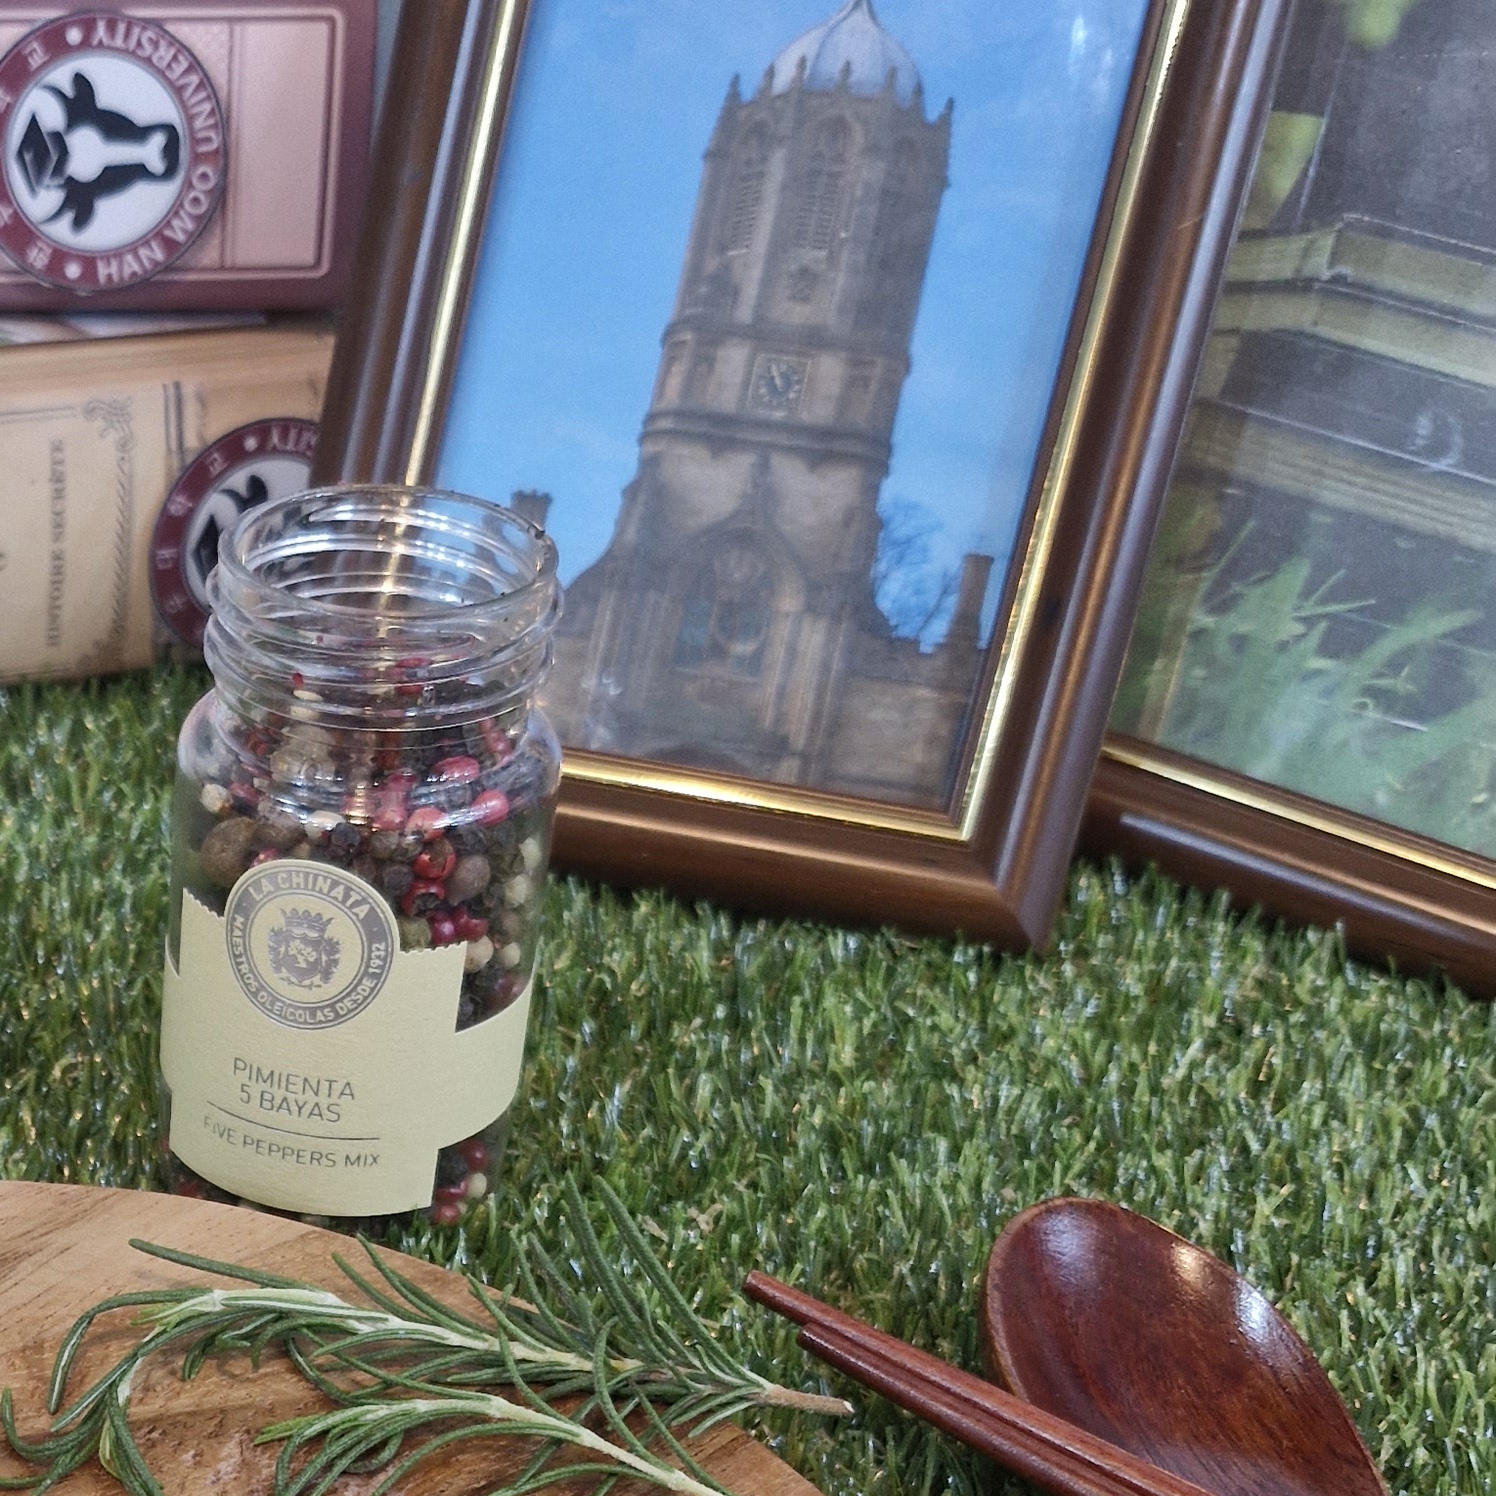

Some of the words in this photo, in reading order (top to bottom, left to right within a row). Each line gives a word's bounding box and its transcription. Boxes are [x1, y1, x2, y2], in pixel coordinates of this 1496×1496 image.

[91, 18, 220, 154] UNIVERSITY
[163, 166, 218, 246] WOO
[96, 239, 167, 285] HAN
[247, 877, 275, 902] LA
[277, 871, 372, 920] CHINATA
[232, 914, 260, 994] MAESTROS
[335, 976, 378, 1016] DESDE
[368, 941, 387, 975] 1932
[232, 1056, 356, 1101] PIMIENTA
[239, 1083, 252, 1105] 5
[259, 1090, 342, 1123] BAYAS
[204, 1114, 237, 1146] FIVE
[242, 1134, 337, 1168] PEPPERS
[344, 1153, 381, 1168] MIX
